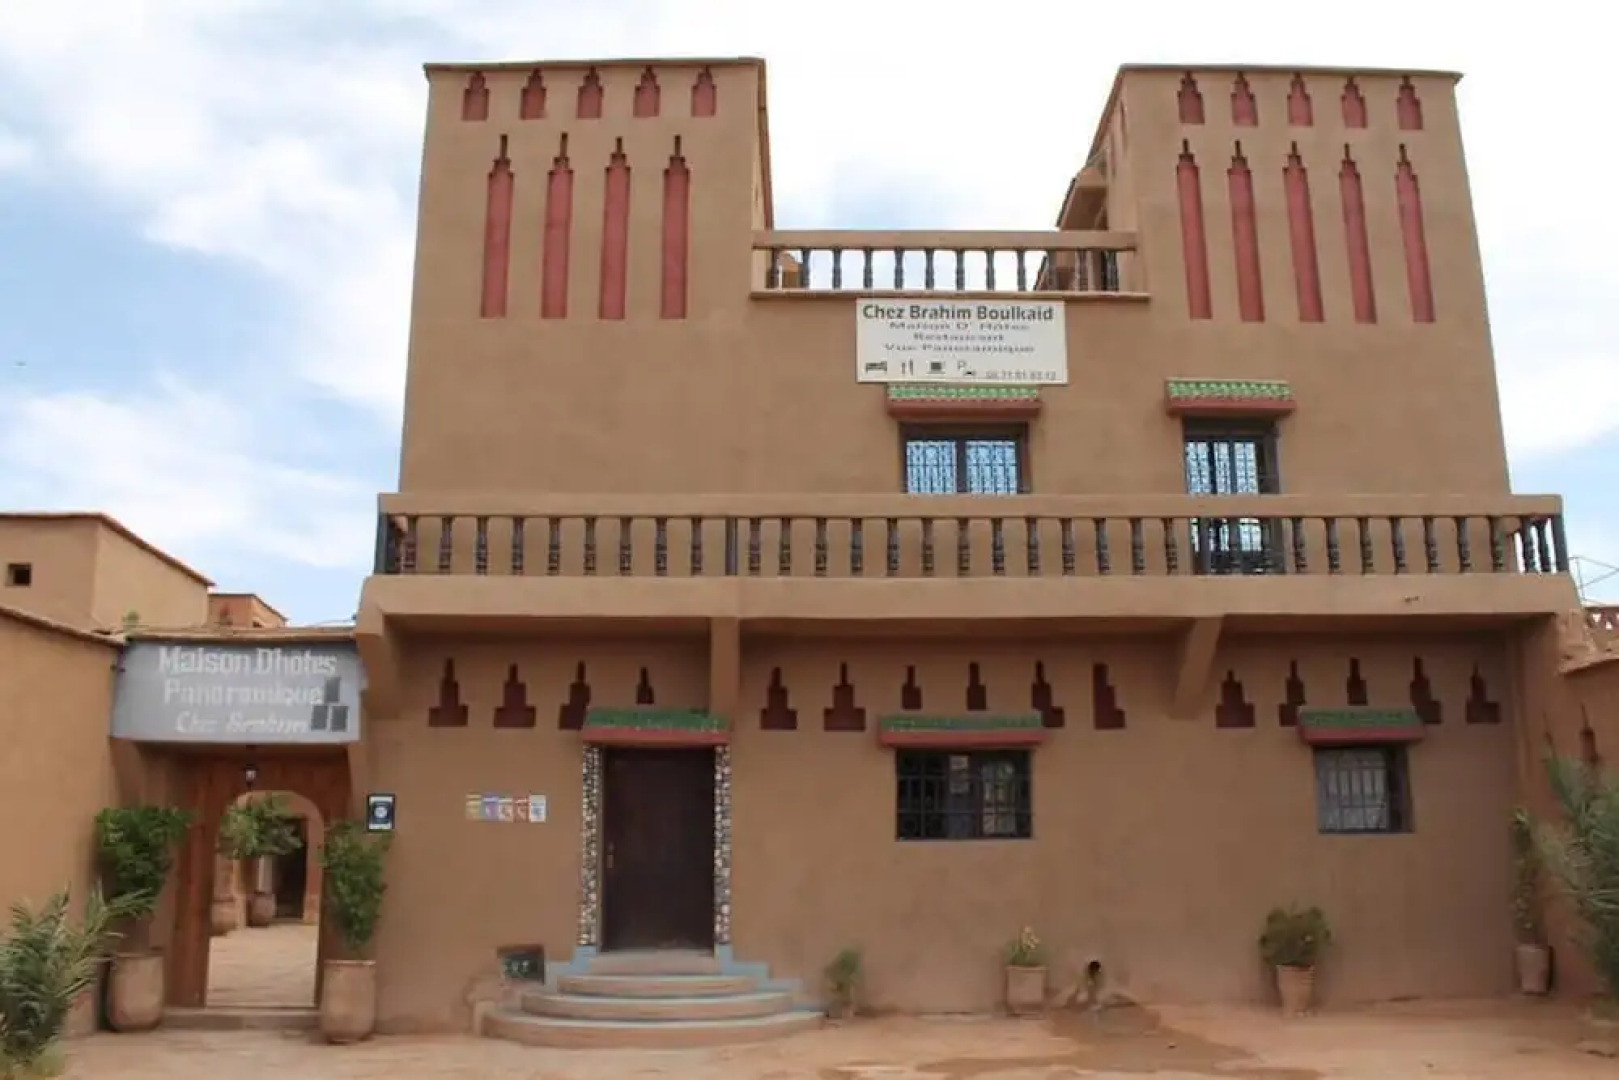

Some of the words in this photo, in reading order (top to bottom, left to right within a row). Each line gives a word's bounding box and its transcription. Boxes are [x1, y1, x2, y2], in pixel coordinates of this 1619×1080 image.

[863, 305, 906, 320] Chez
[909, 305, 972, 320] Brahim
[977, 305, 1054, 321] Boulkaid
[159, 646, 249, 674] Maison
[164, 677, 324, 707] Panoramique
